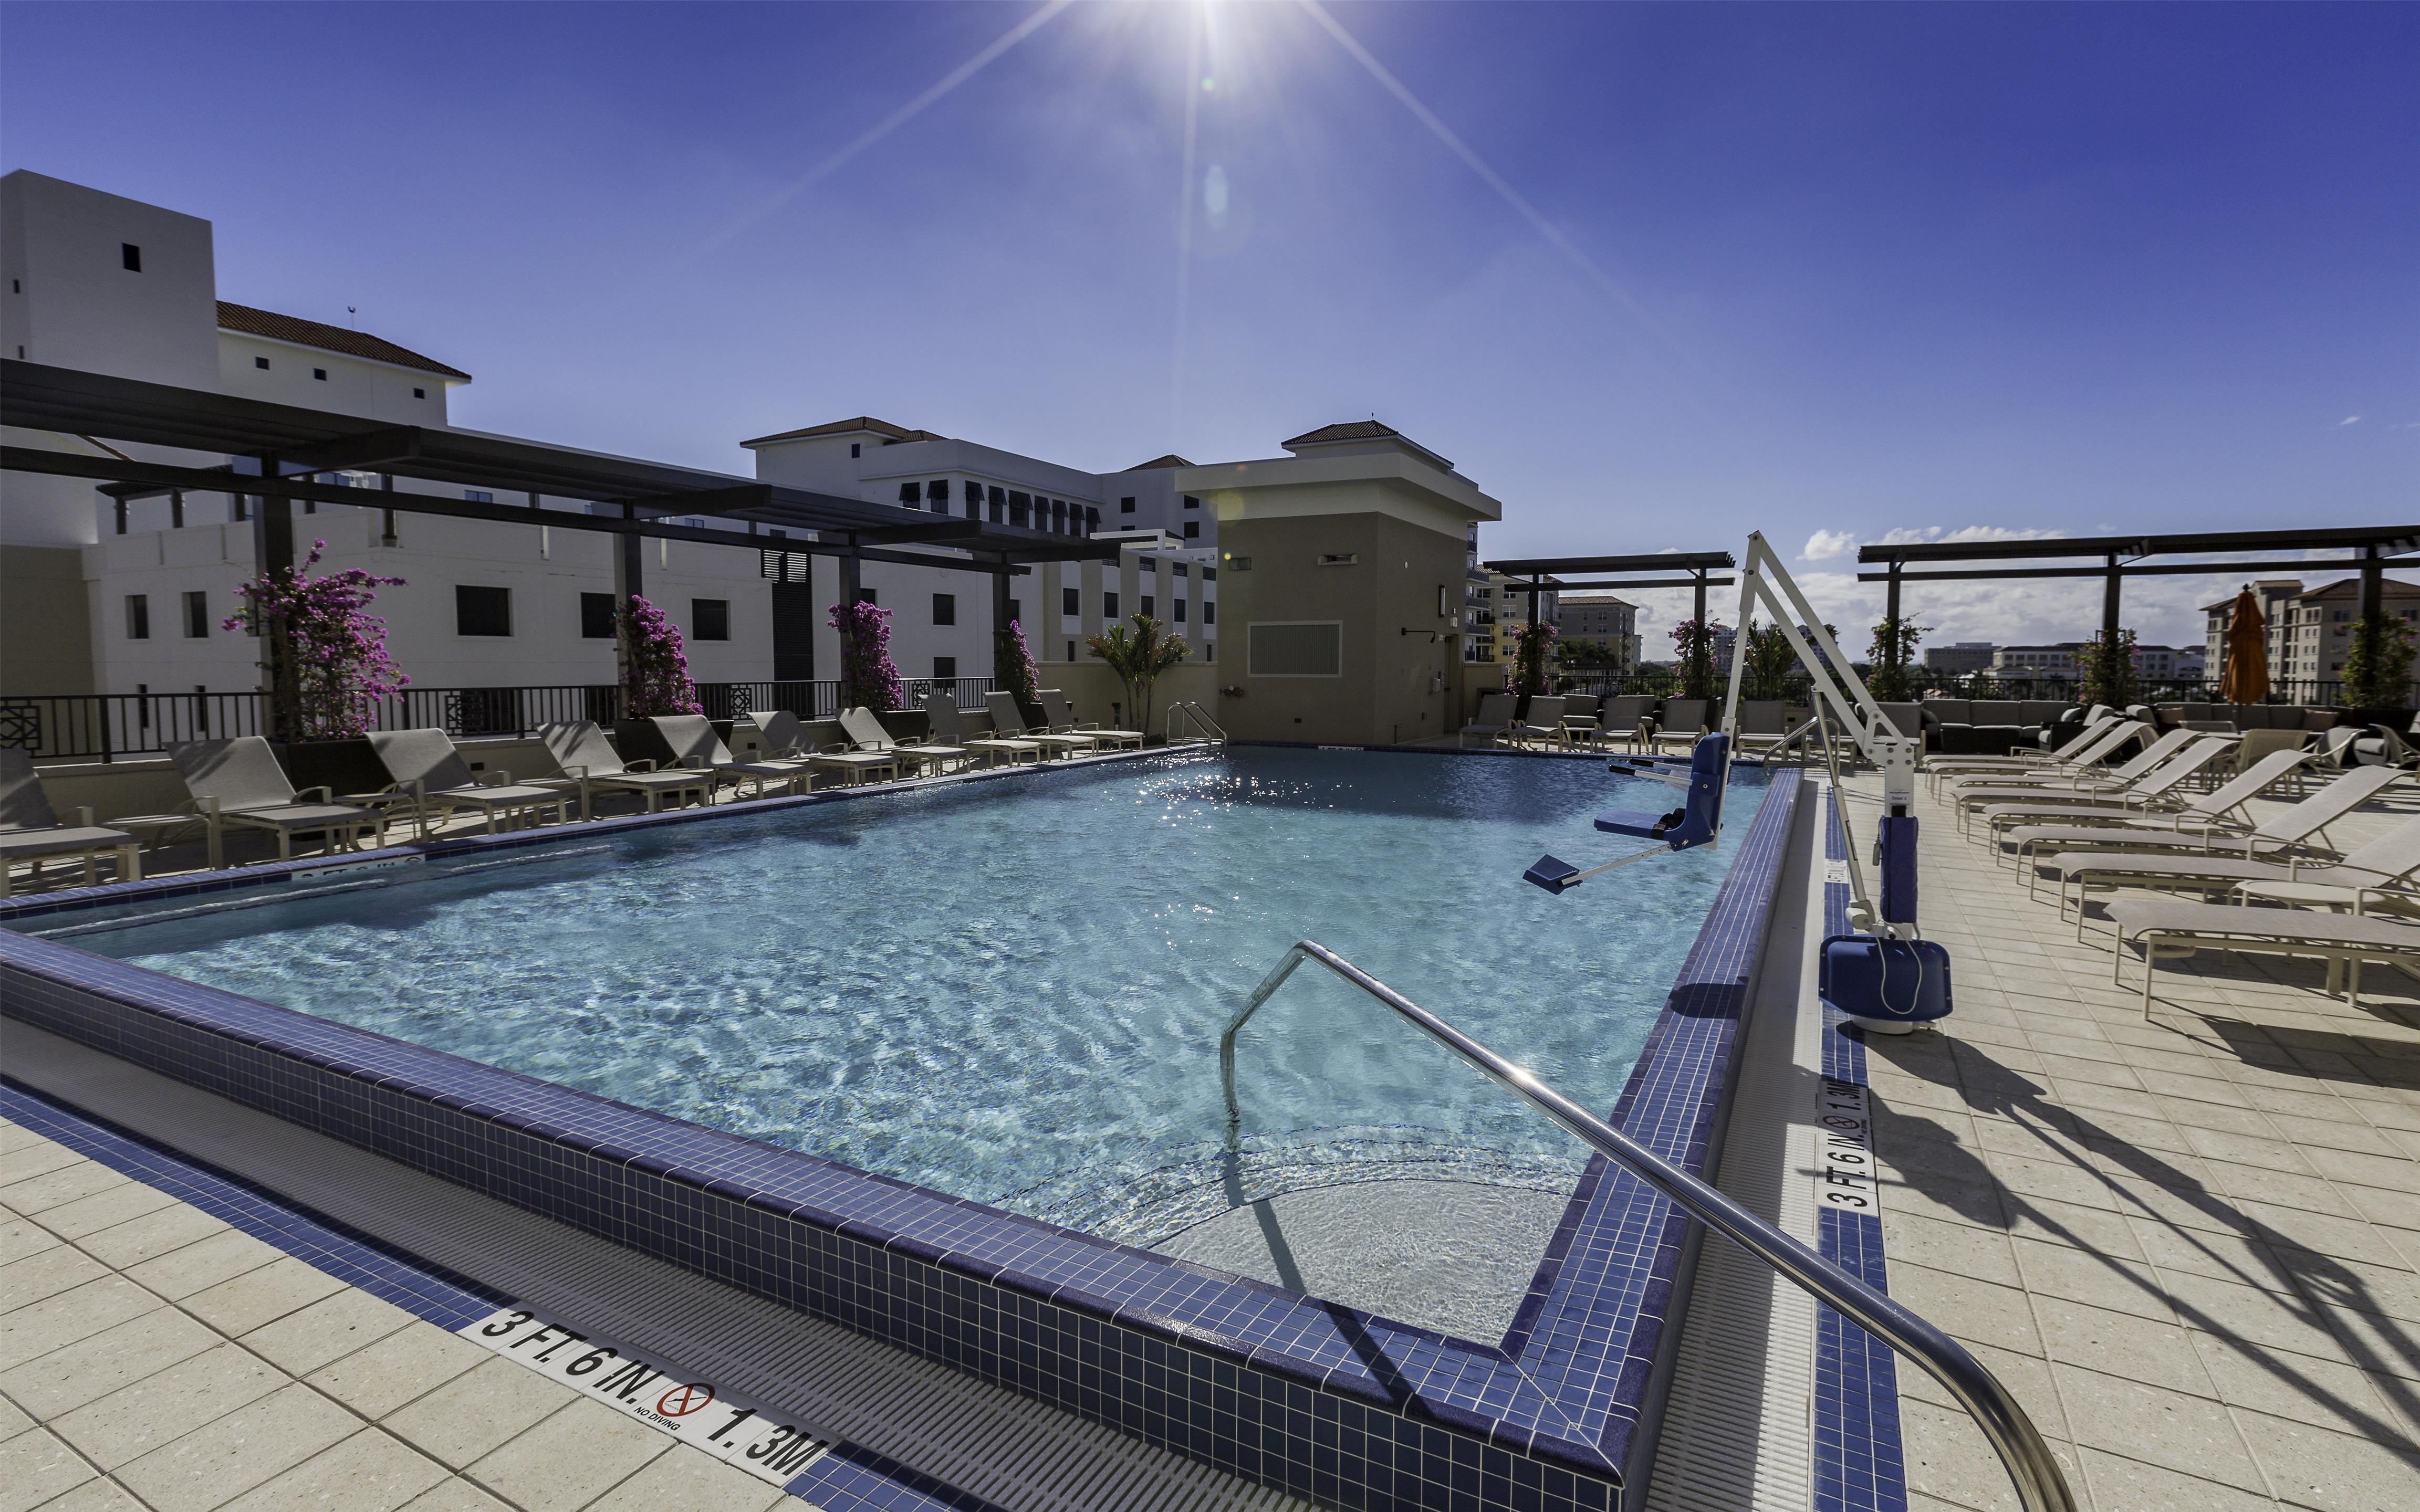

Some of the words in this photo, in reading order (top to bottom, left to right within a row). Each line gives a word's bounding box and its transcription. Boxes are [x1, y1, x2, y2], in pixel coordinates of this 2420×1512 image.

[1828, 1133, 1865, 1151] IN.
[1827, 1152, 1865, 1164] 6
[1826, 1166, 1866, 1190] FT.
[1827, 1193, 1868, 1207] 3
[482, 1310, 535, 1337] 3
[509, 1322, 590, 1363] FT.
[566, 1347, 619, 1376] 6
[592, 1359, 666, 1404] IN.
[633, 1406, 650, 1416] NO
[648, 1413, 681, 1431] DIVING
